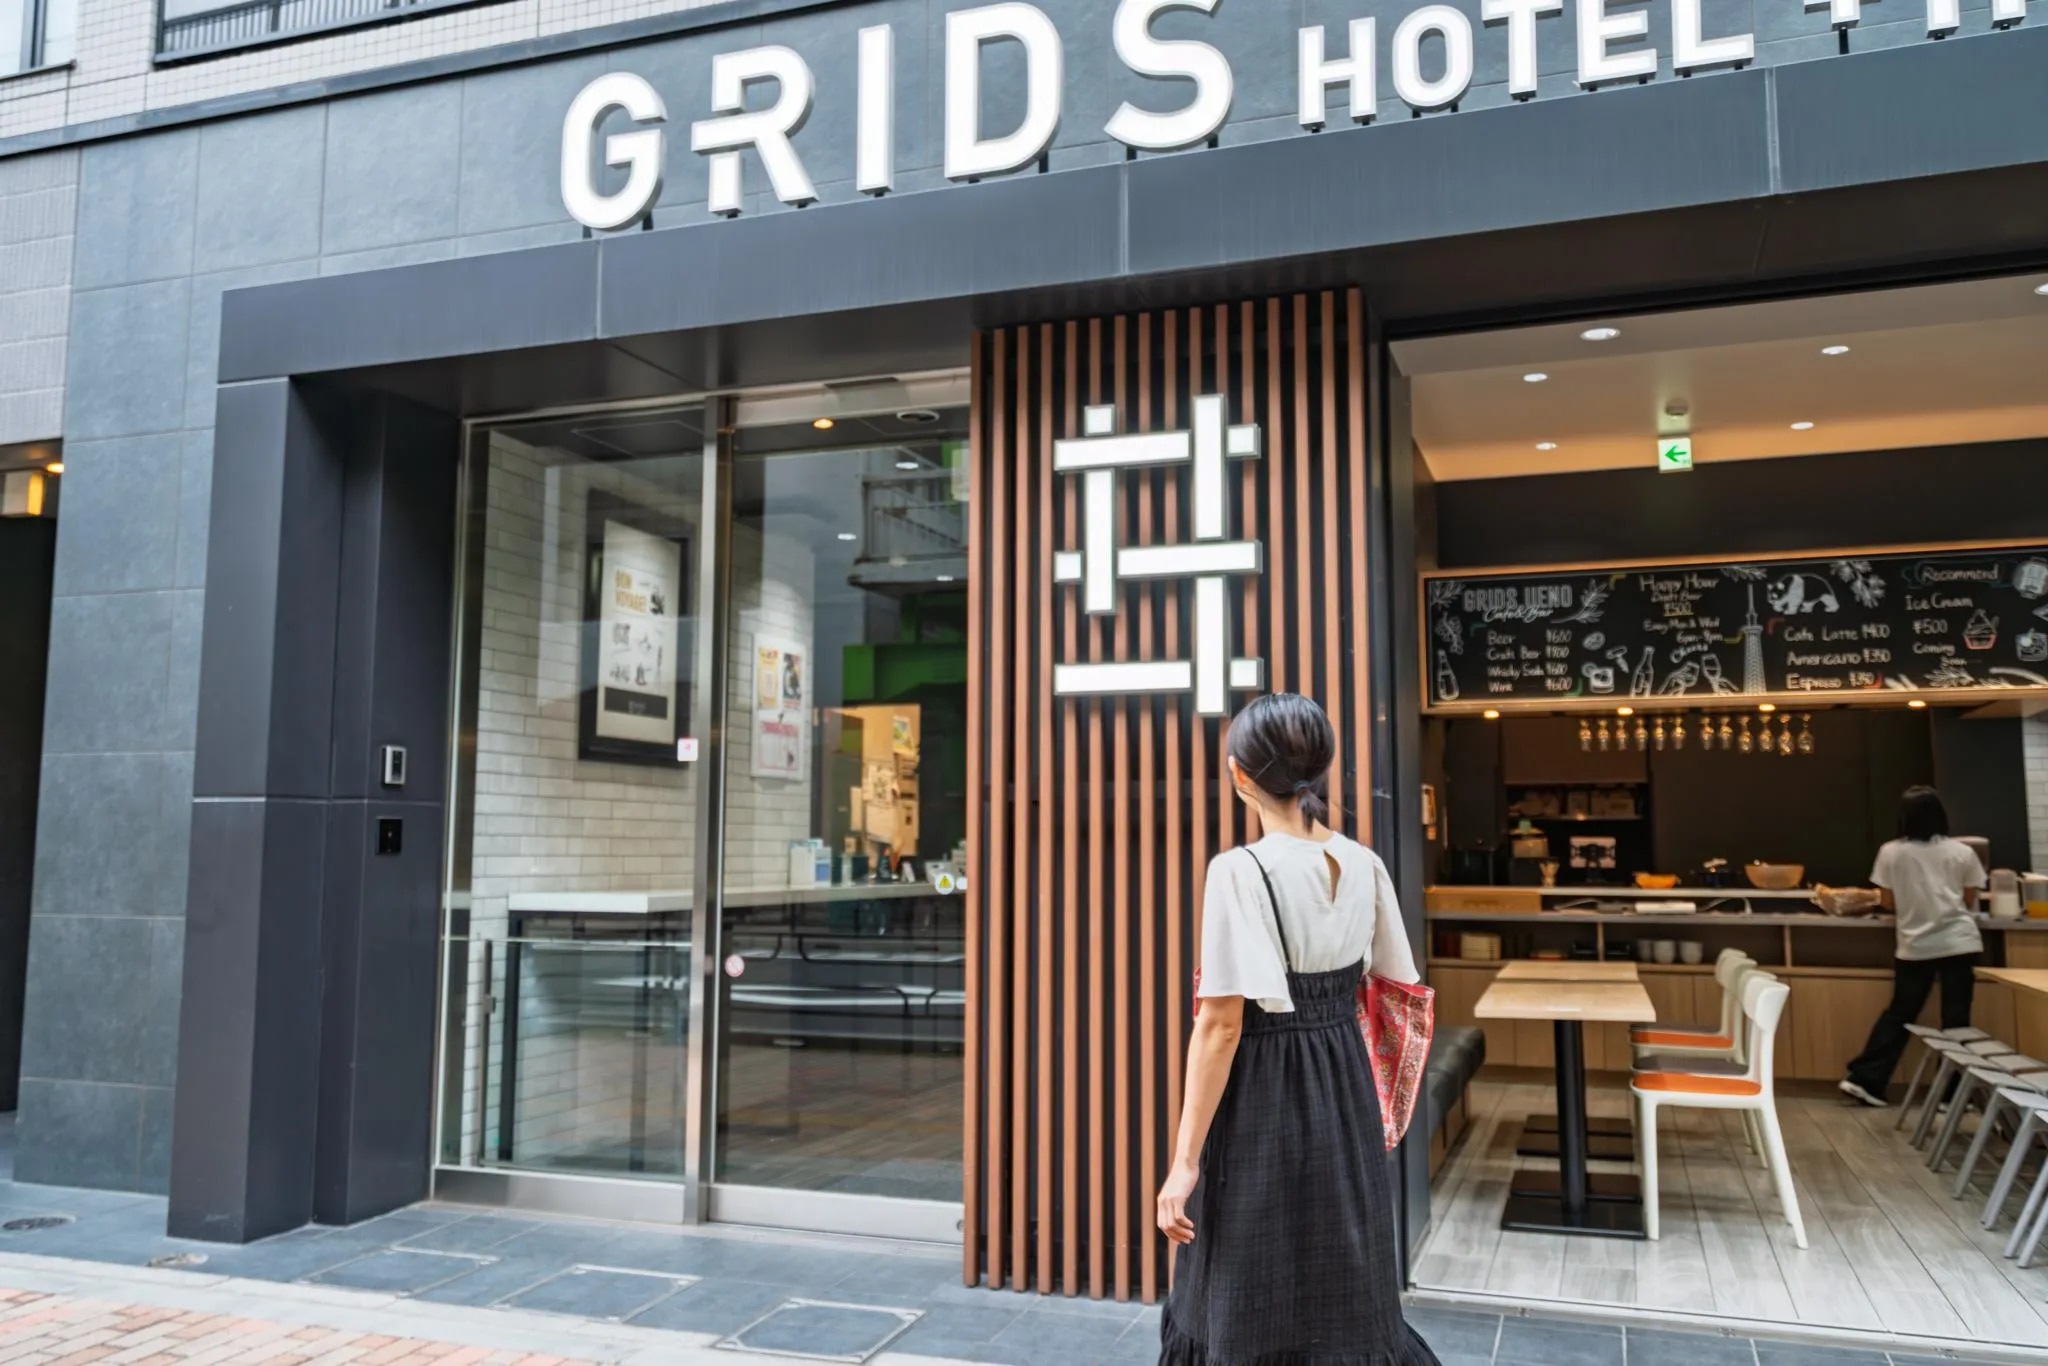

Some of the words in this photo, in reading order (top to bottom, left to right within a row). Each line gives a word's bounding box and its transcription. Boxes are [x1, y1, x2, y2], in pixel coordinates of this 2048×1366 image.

[560, 0, 1234, 232] GRIDS
[1298, 0, 1756, 130] HOTEL
[1463, 588, 1518, 612] GRIDS
[1524, 585, 1573, 608] UENO
